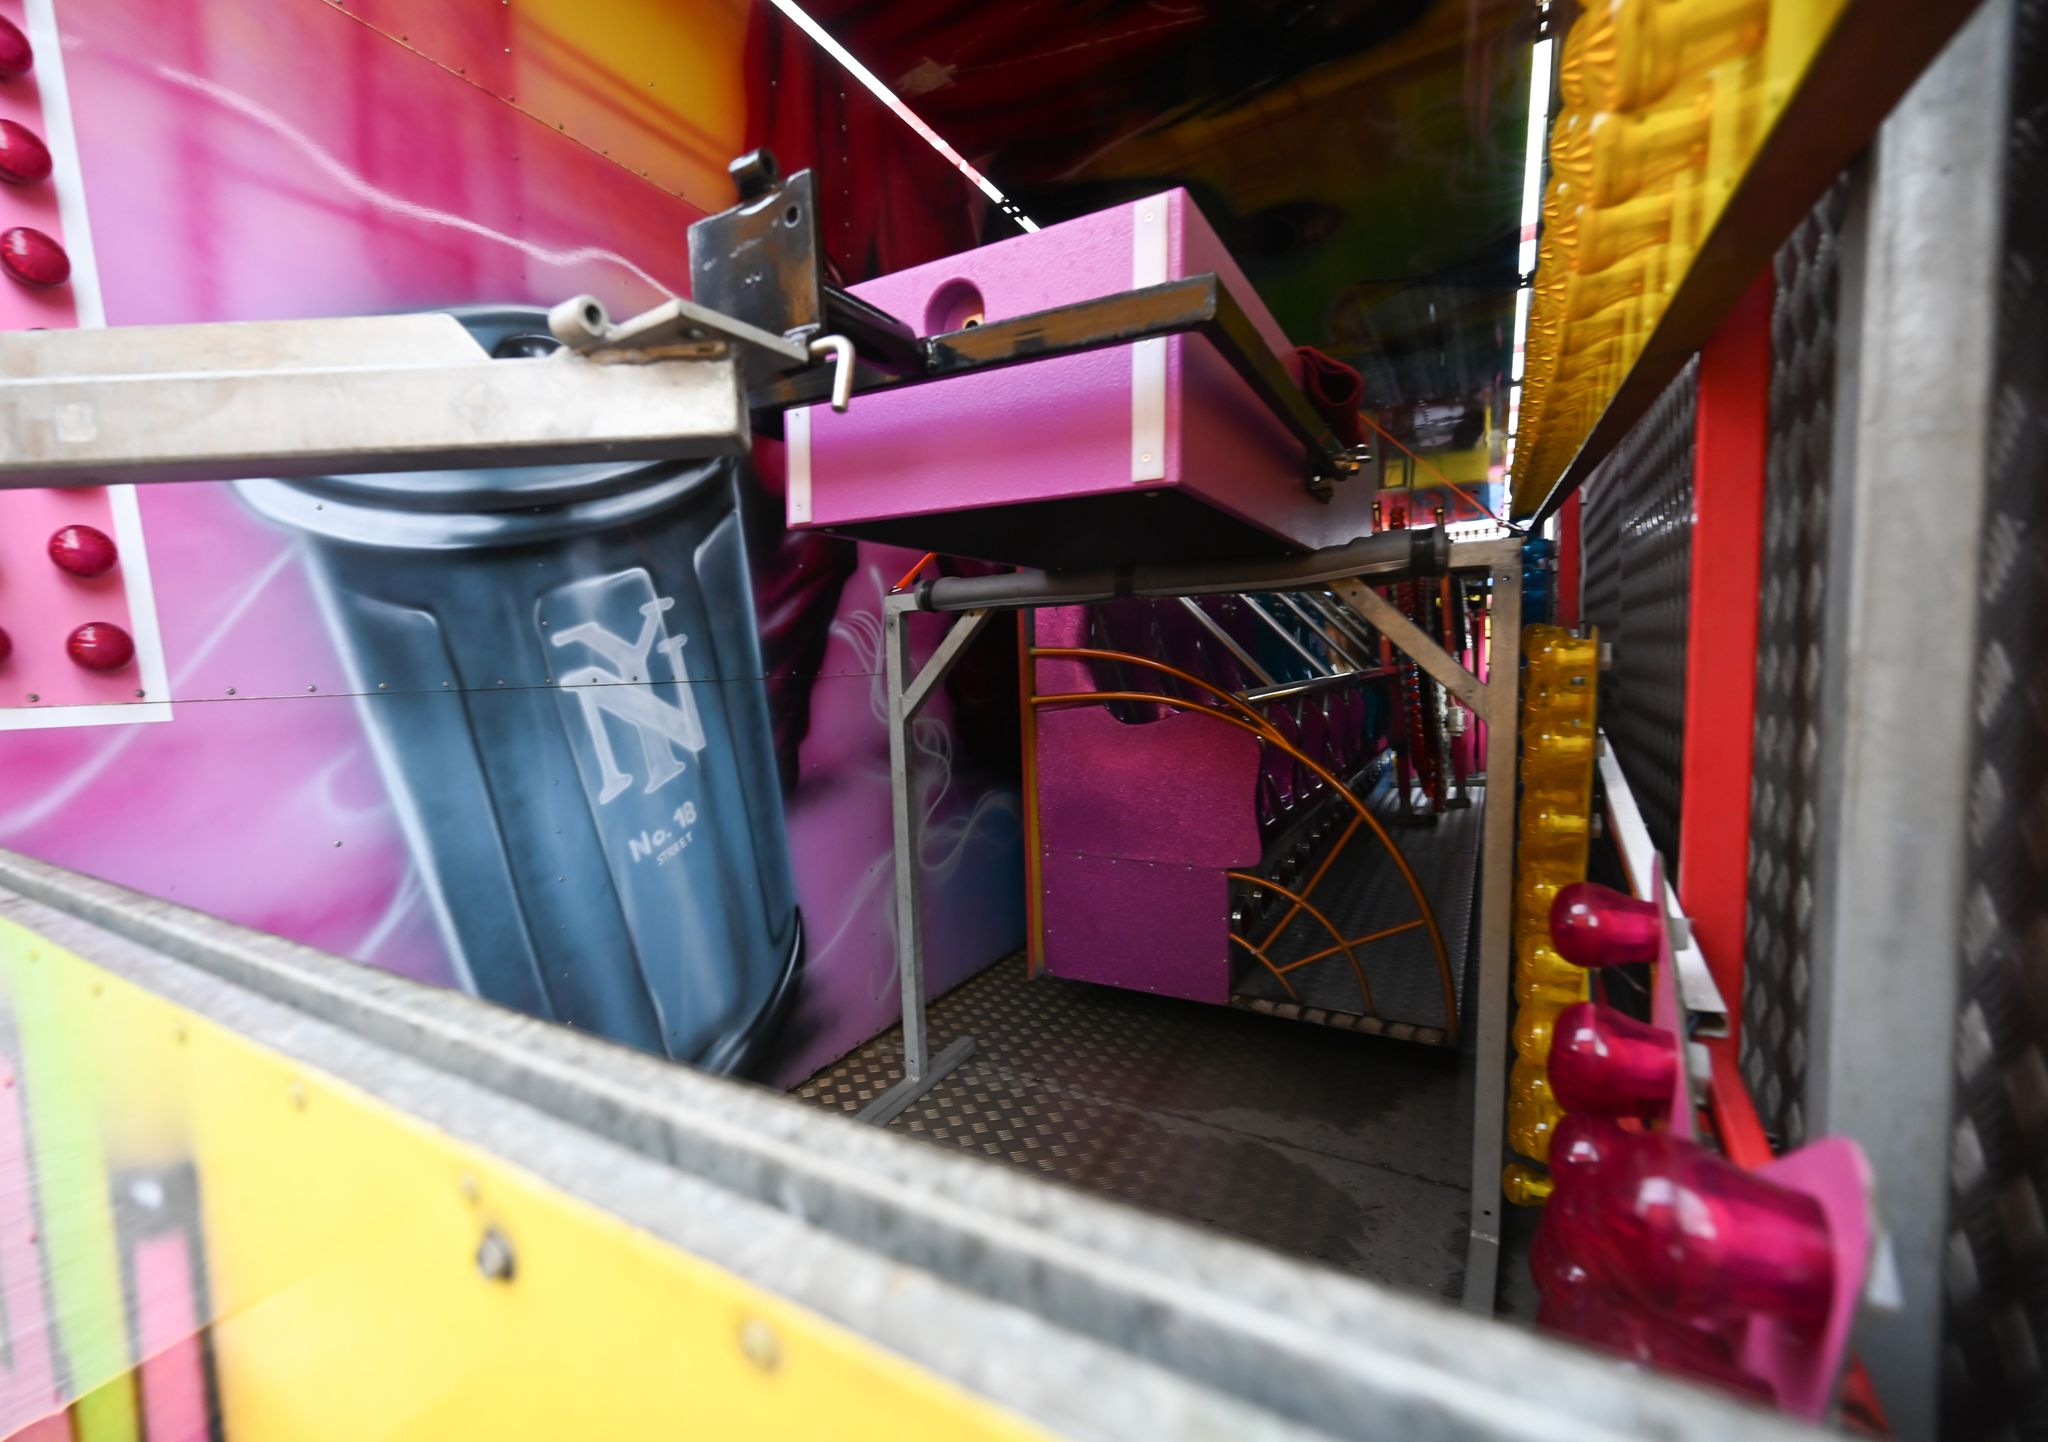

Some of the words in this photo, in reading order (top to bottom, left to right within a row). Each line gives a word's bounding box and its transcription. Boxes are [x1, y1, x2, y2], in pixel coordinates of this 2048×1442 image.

[628, 829, 672, 863] No.
[673, 800, 697, 829] 18
[656, 831, 693, 866] STREET
